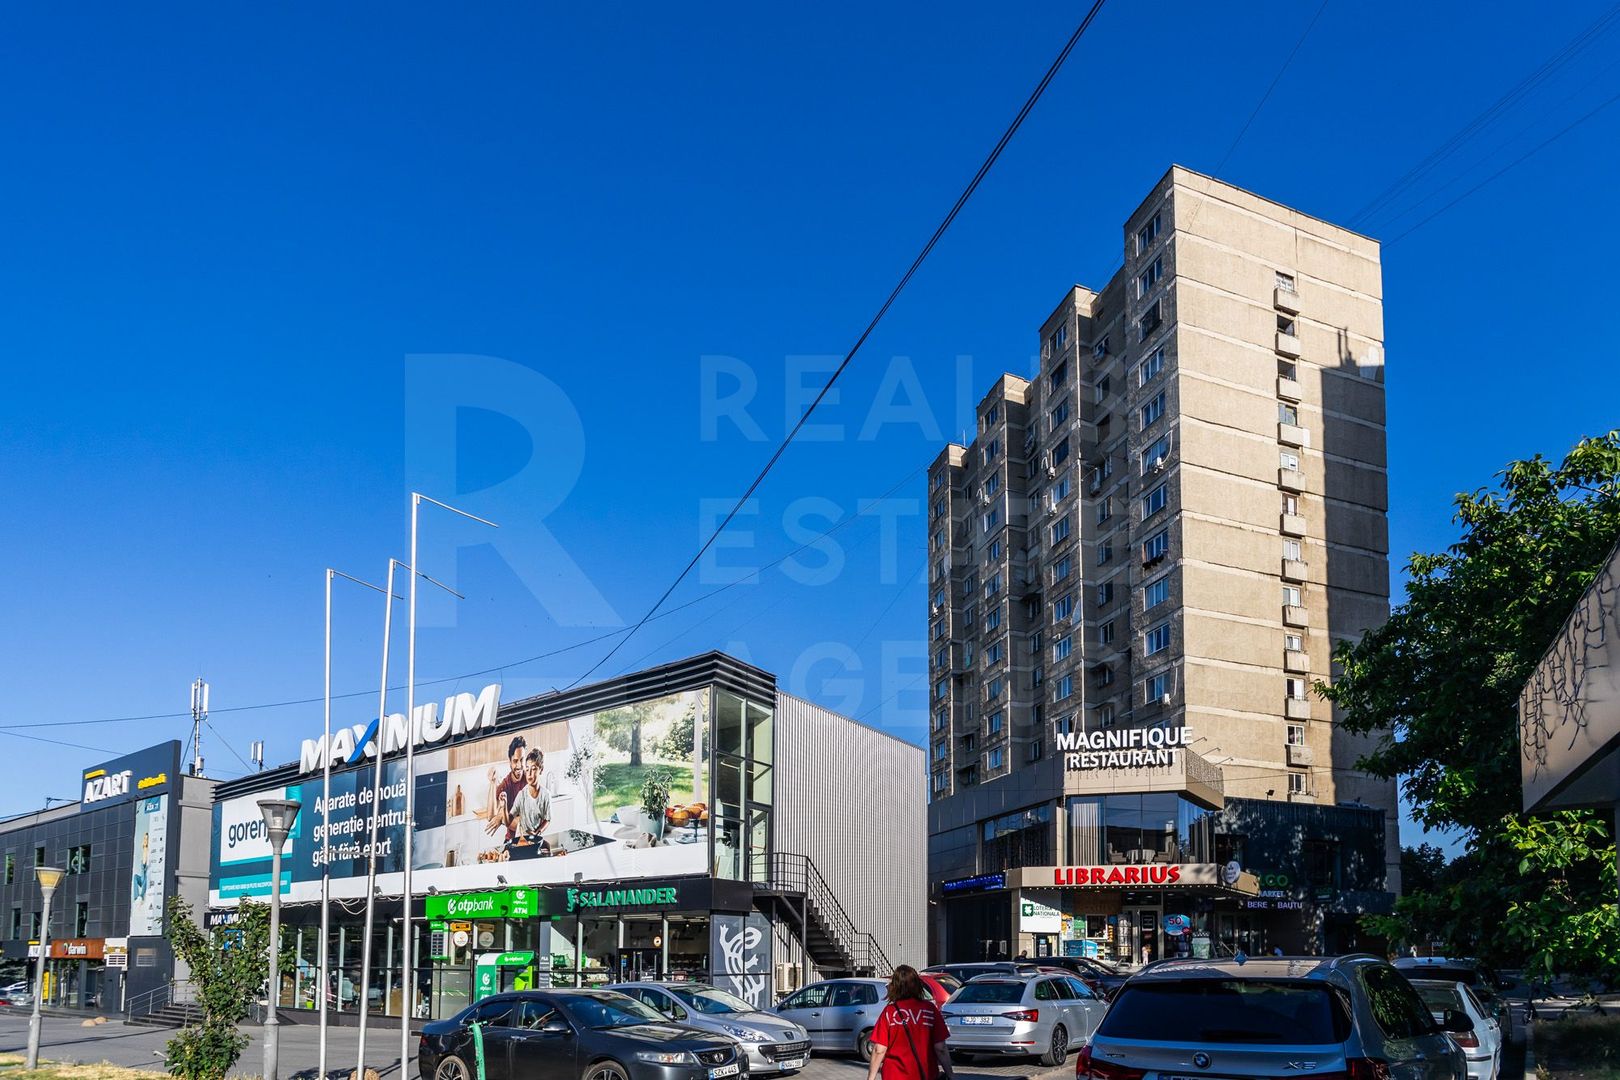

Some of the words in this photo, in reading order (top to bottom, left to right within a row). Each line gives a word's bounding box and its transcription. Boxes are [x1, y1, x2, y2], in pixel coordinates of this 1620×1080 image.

[1056, 726, 1194, 751] MAGNIFIQUE
[1069, 748, 1181, 769] RESTAURANT
[84, 770, 133, 804] AZART
[358, 787, 373, 805] de
[1054, 865, 1181, 886] LIBRARIUS
[457, 897, 494, 914] otpbank
[580, 887, 678, 908] SALAMANDER
[1247, 901, 1268, 909] BERE
[512, 906, 528, 915] ATM
[885, 1008, 935, 1027] LOVE
